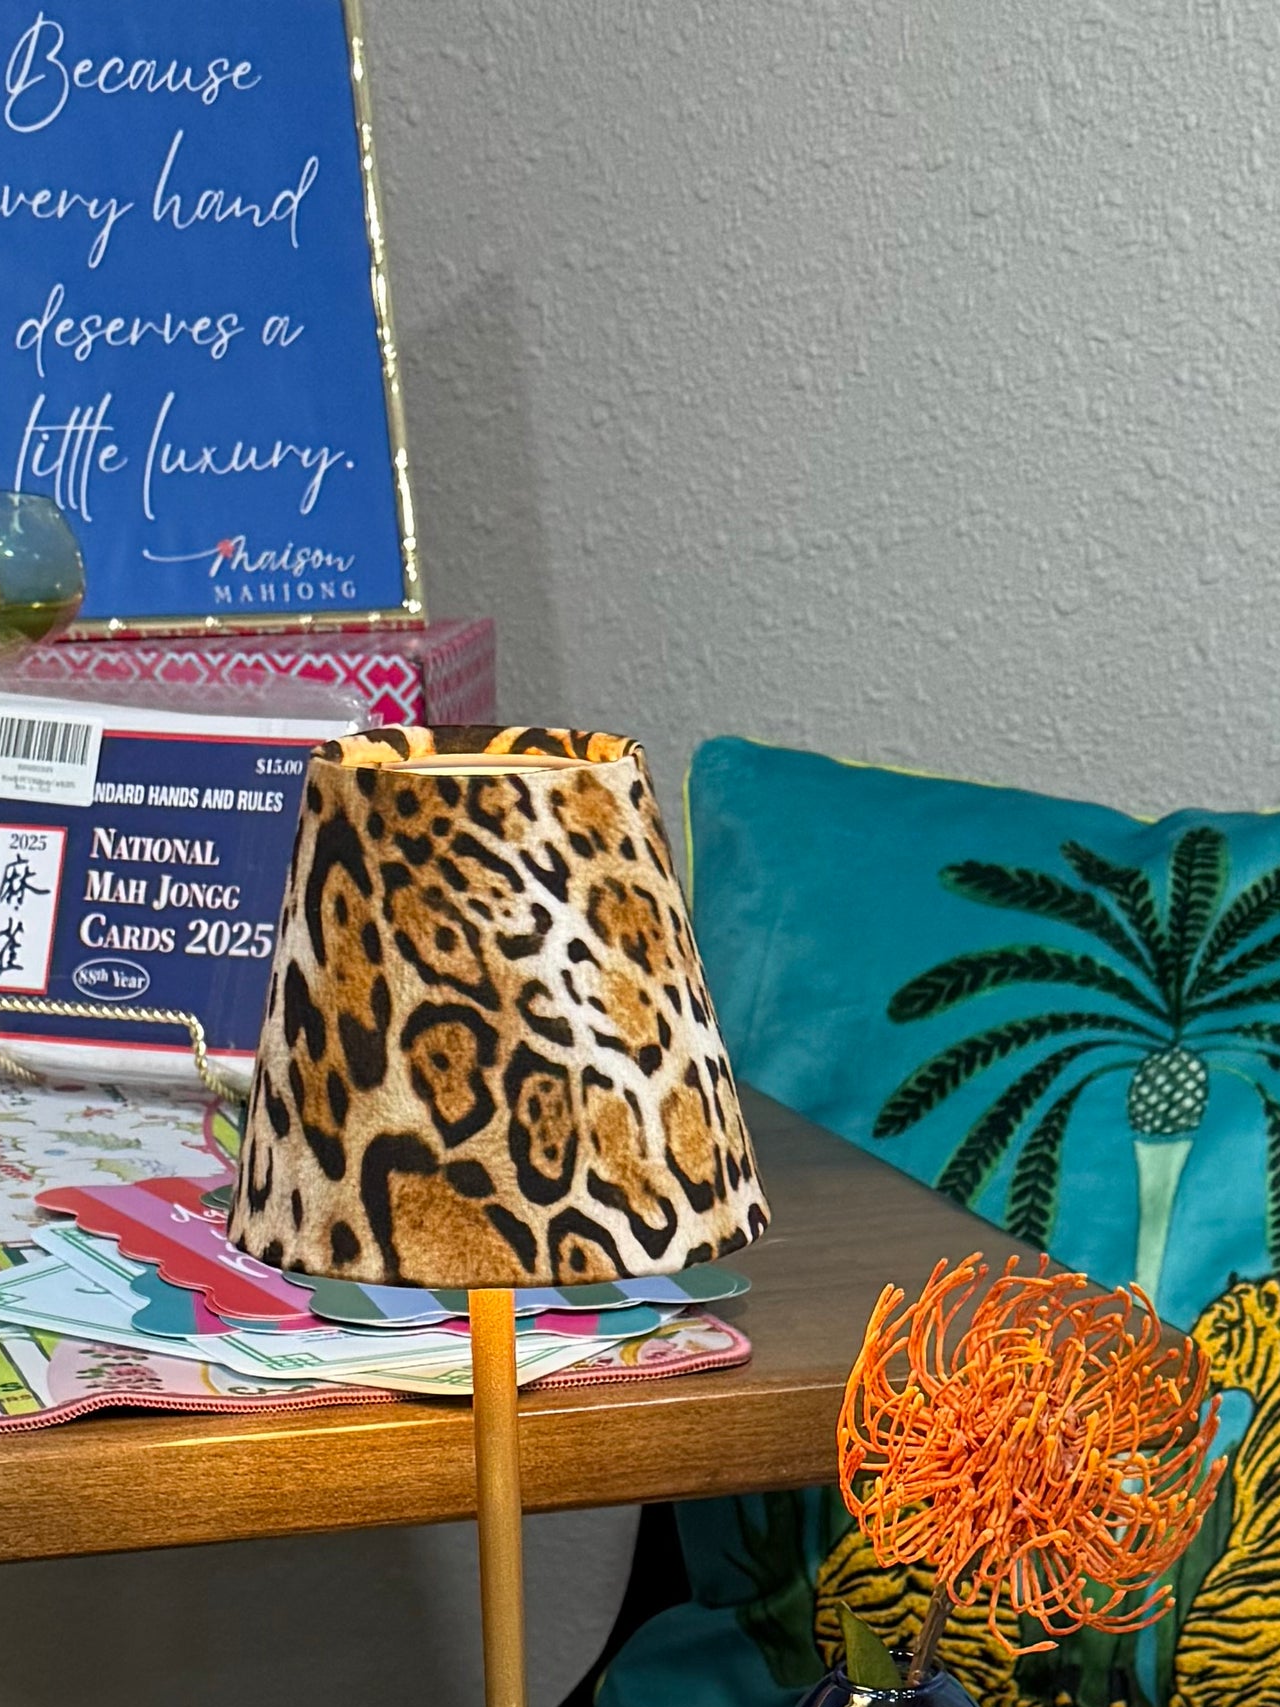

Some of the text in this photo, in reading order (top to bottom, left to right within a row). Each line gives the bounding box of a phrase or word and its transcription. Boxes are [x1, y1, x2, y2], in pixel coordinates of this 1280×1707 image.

[5, 11, 262, 133] Because
[153, 130, 320, 249] hand
[15, 283, 304, 377] deserves a
[13, 391, 356, 522] little luxury.
[213, 581, 358, 604] MAHJONG
[256, 757, 304, 776] $15.00
[93, 783, 145, 807] NDARD
[147, 786, 199, 809] HANDS
[202, 788, 235, 810] AND
[238, 790, 284, 814] RULES
[9, 834, 48, 852] 2025
[90, 827, 220, 867] NATIONAL
[184, 919, 275, 959] 2025
[76, 967, 147, 989] 88th Year
